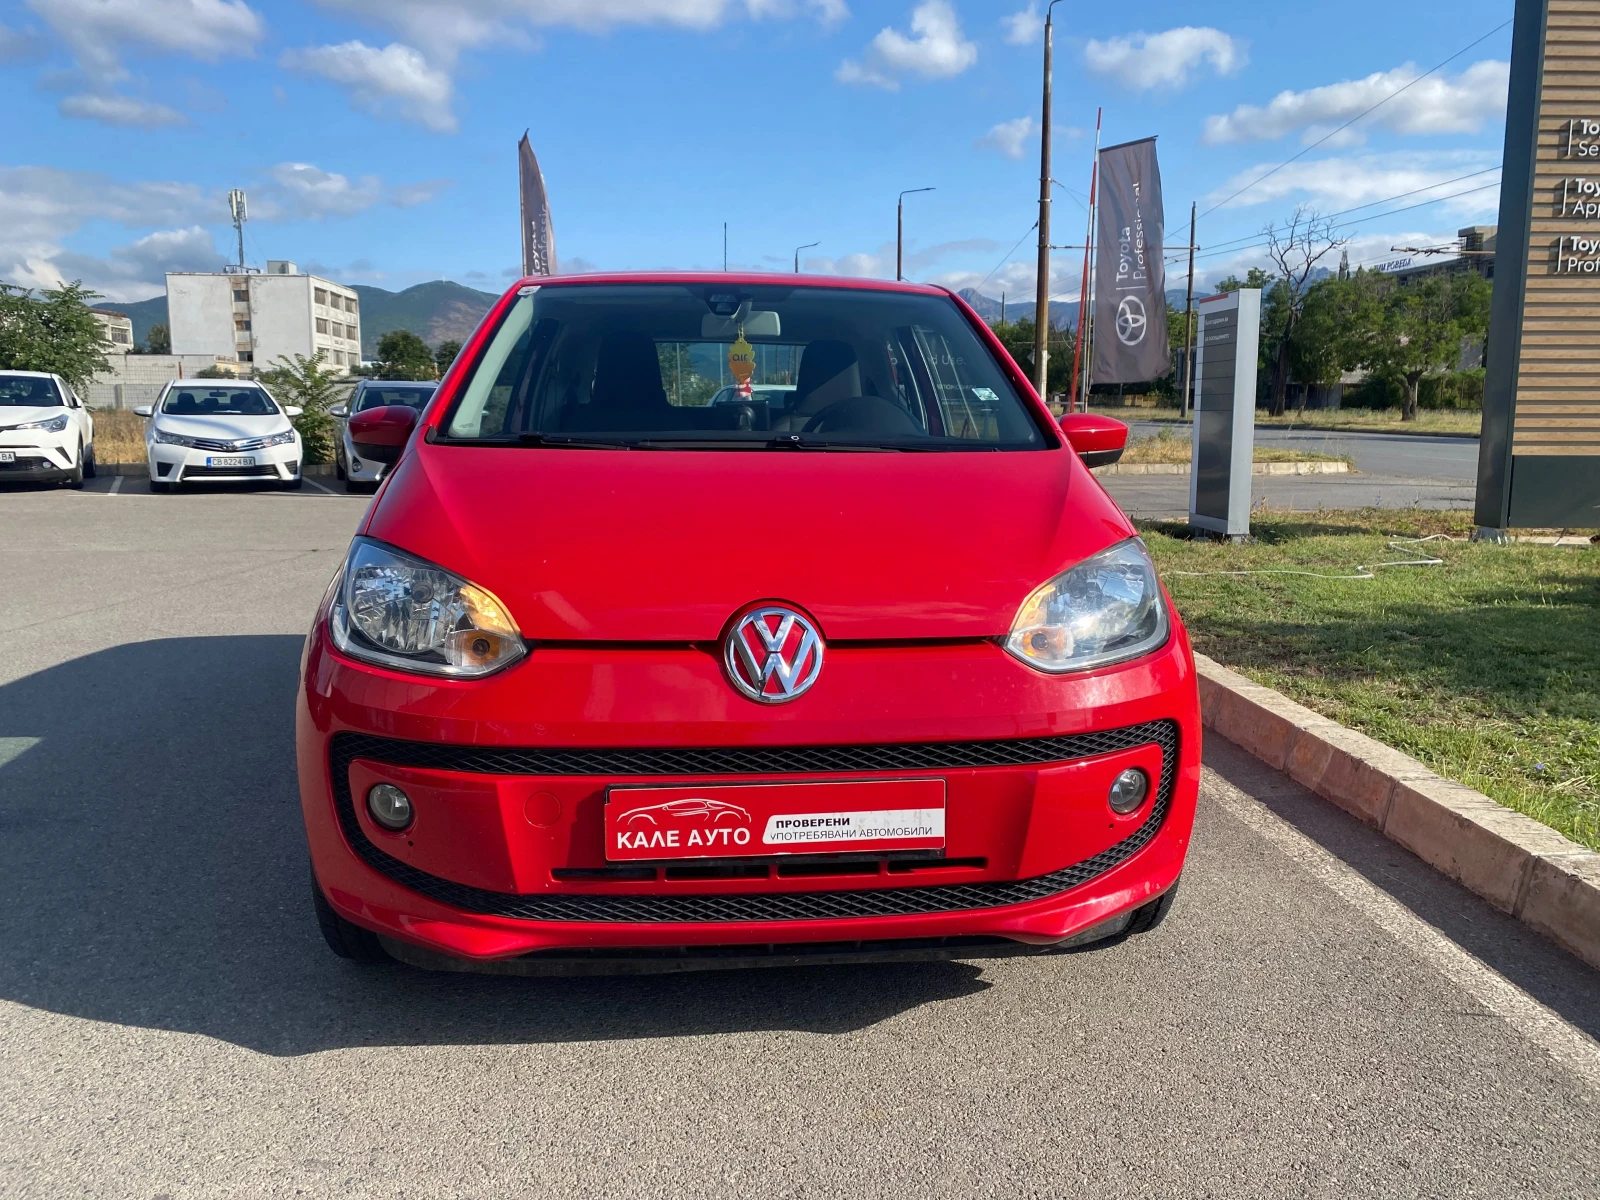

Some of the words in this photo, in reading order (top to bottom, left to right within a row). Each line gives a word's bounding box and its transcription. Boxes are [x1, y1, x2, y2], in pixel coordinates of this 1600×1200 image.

[1580, 119, 1600, 138] To
[1572, 200, 1600, 218] Ap
[1571, 236, 1600, 254] Toy
[1116, 227, 1132, 282] Toyota
[775, 817, 850, 829] ПРОВЕРЕНИ
[617, 830, 680, 849] КАЛЕ
[687, 827, 750, 847] АУТО
[770, 829, 857, 841] УПОТРЕБЯВАНИ
[859, 826, 933, 838] АВТОМОБИЛИ
